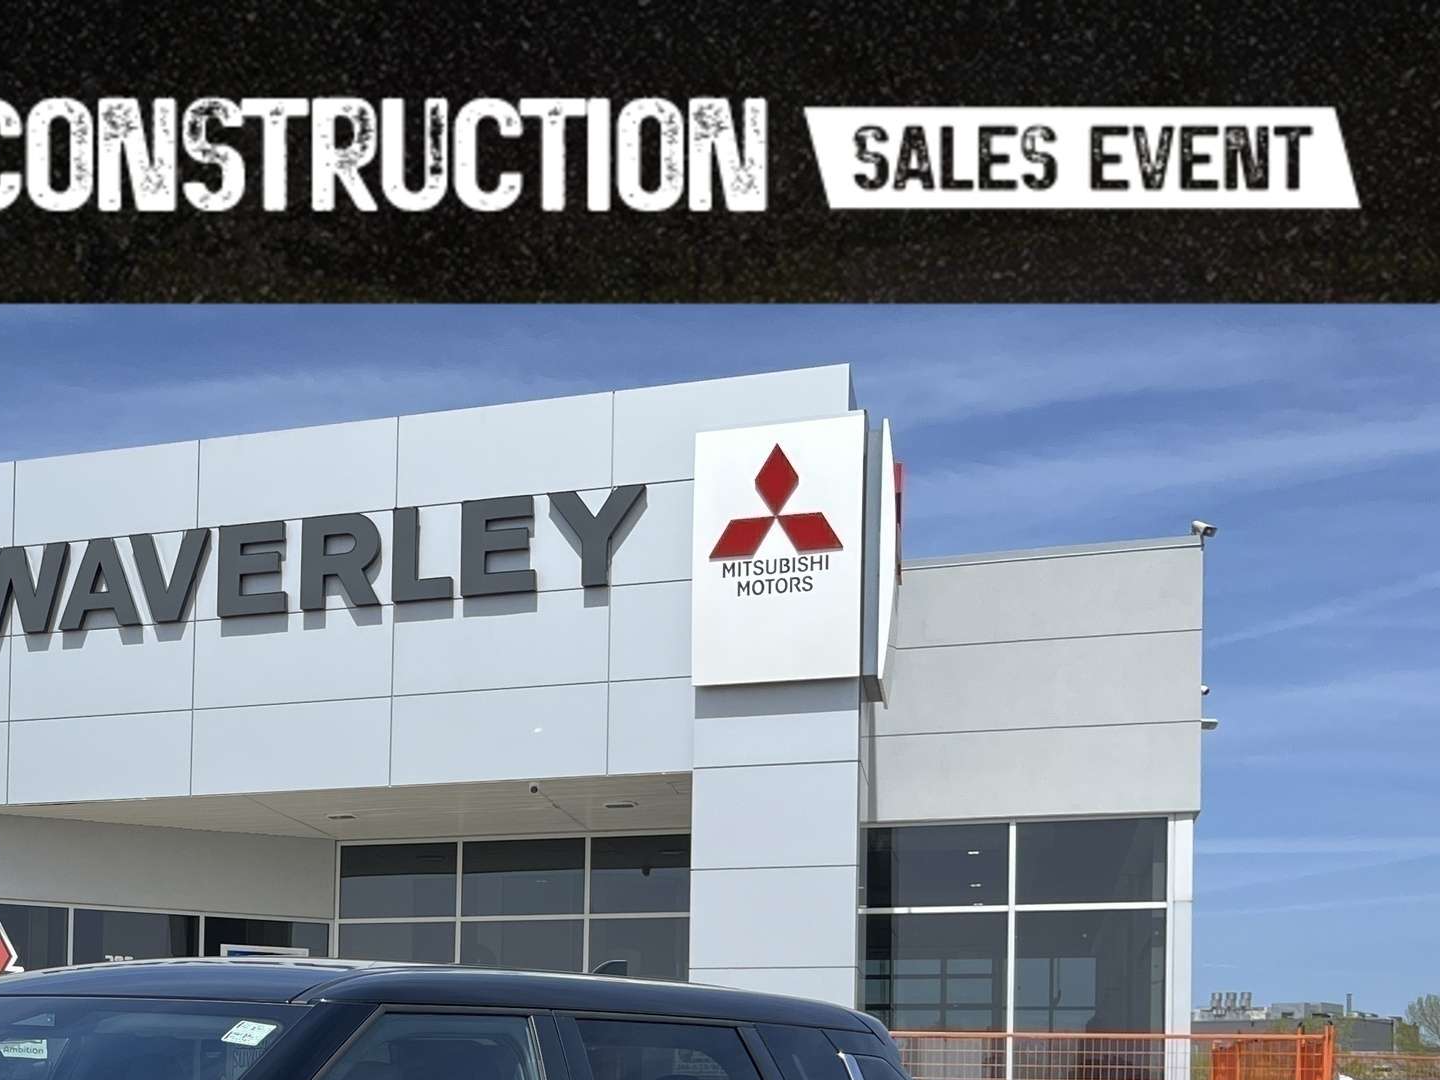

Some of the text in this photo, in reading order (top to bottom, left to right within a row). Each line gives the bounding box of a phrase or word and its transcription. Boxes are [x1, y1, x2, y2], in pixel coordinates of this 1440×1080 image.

[722, 554, 829, 578] MITSUBISHI
[737, 576, 814, 597] MOTORS
[3, 1045, 44, 1054] Ambition
